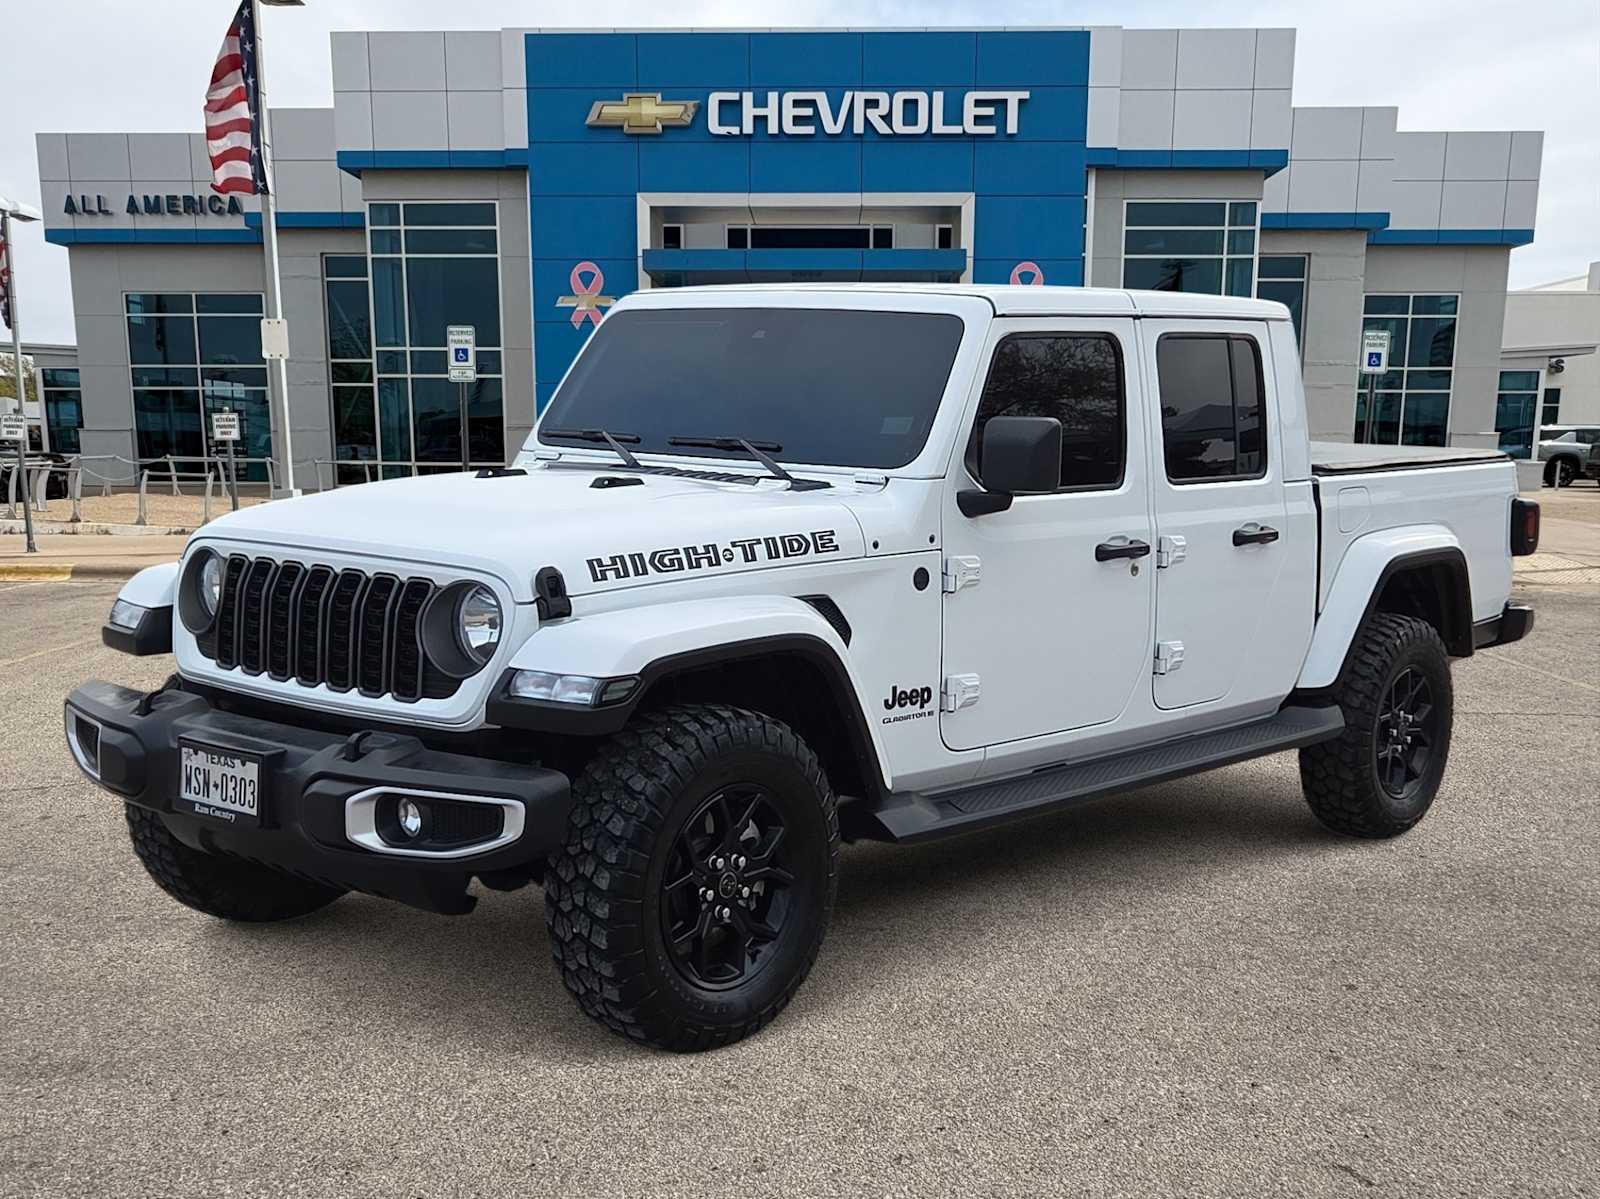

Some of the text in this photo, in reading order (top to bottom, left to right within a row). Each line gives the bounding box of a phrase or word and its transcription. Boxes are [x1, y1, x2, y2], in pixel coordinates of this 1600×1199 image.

[707, 91, 1030, 136] CHEVROLET
[64, 195, 243, 216] ALL AMERICA
[883, 685, 933, 710] Jeep
[882, 711, 927, 724] GLADIATOR
[206, 754, 235, 768] TEXAS
